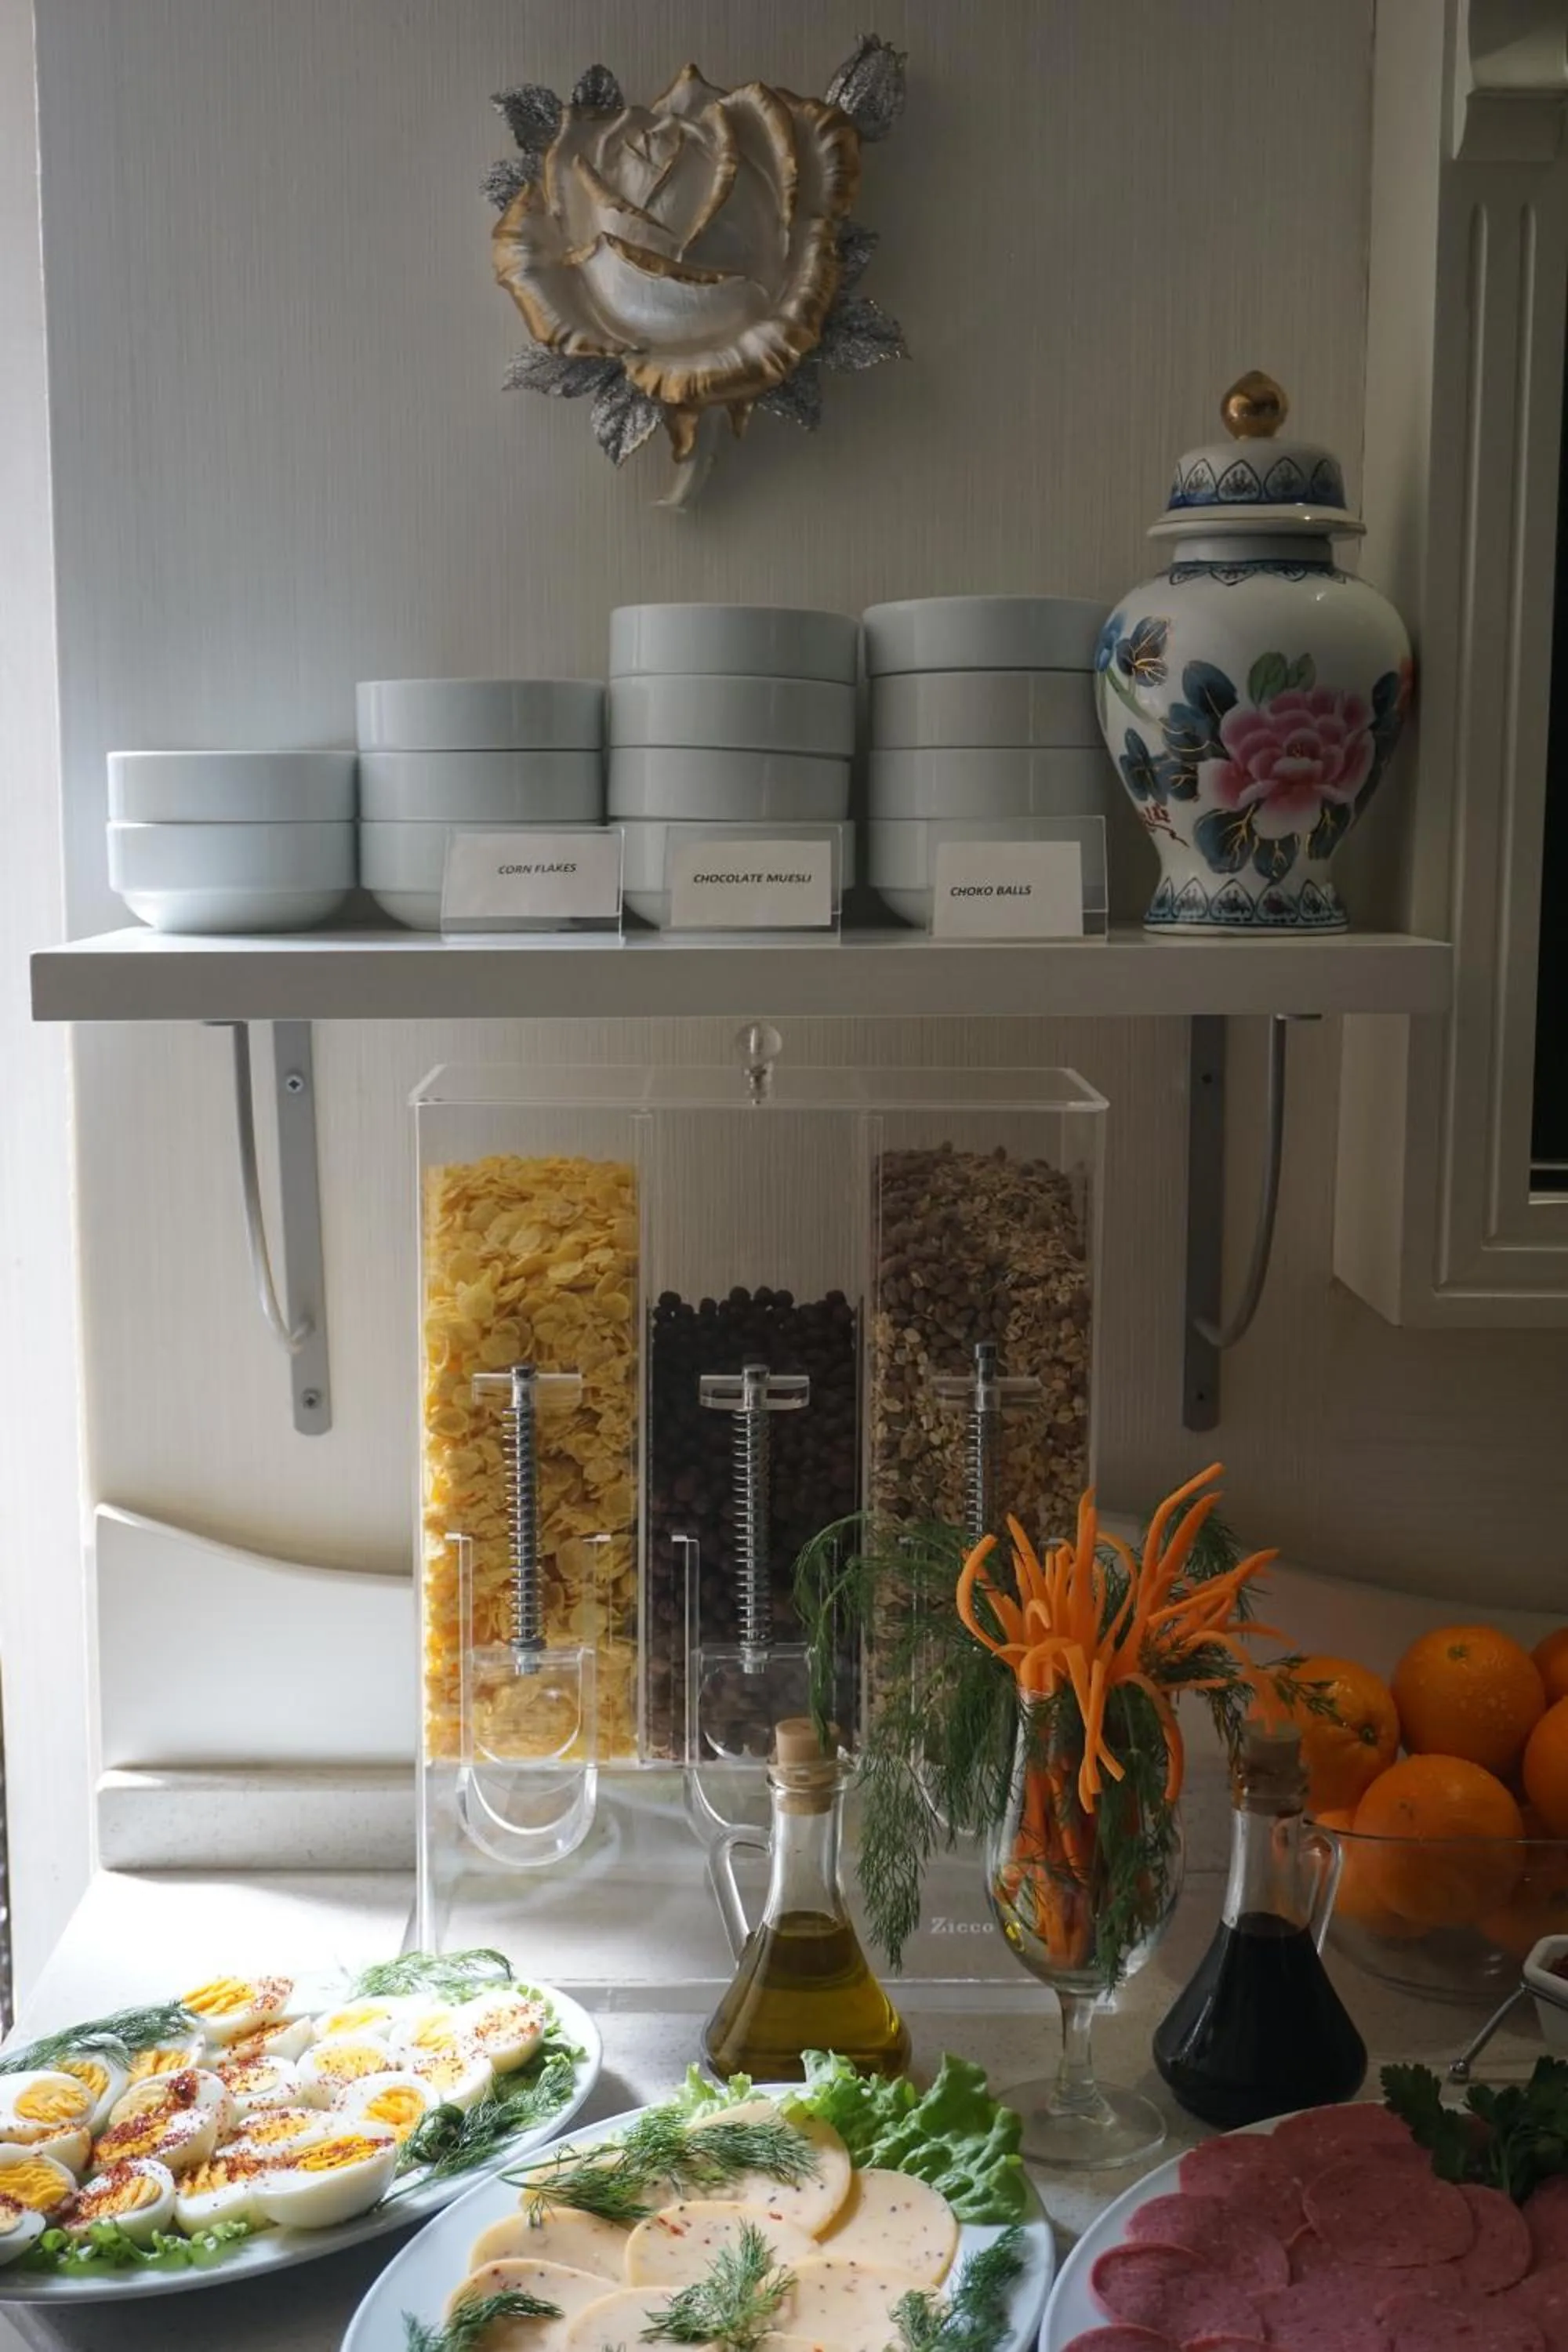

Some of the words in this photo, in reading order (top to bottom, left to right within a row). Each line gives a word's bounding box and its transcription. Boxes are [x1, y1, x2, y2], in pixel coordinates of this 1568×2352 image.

[498, 864, 532, 875] CORN
[534, 863, 577, 873] FLAKES
[693, 873, 763, 884] CHOCOLATE
[766, 873, 812, 884] MUESLI
[949, 886, 993, 897] CHOKO
[996, 884, 1032, 896] BALLS
